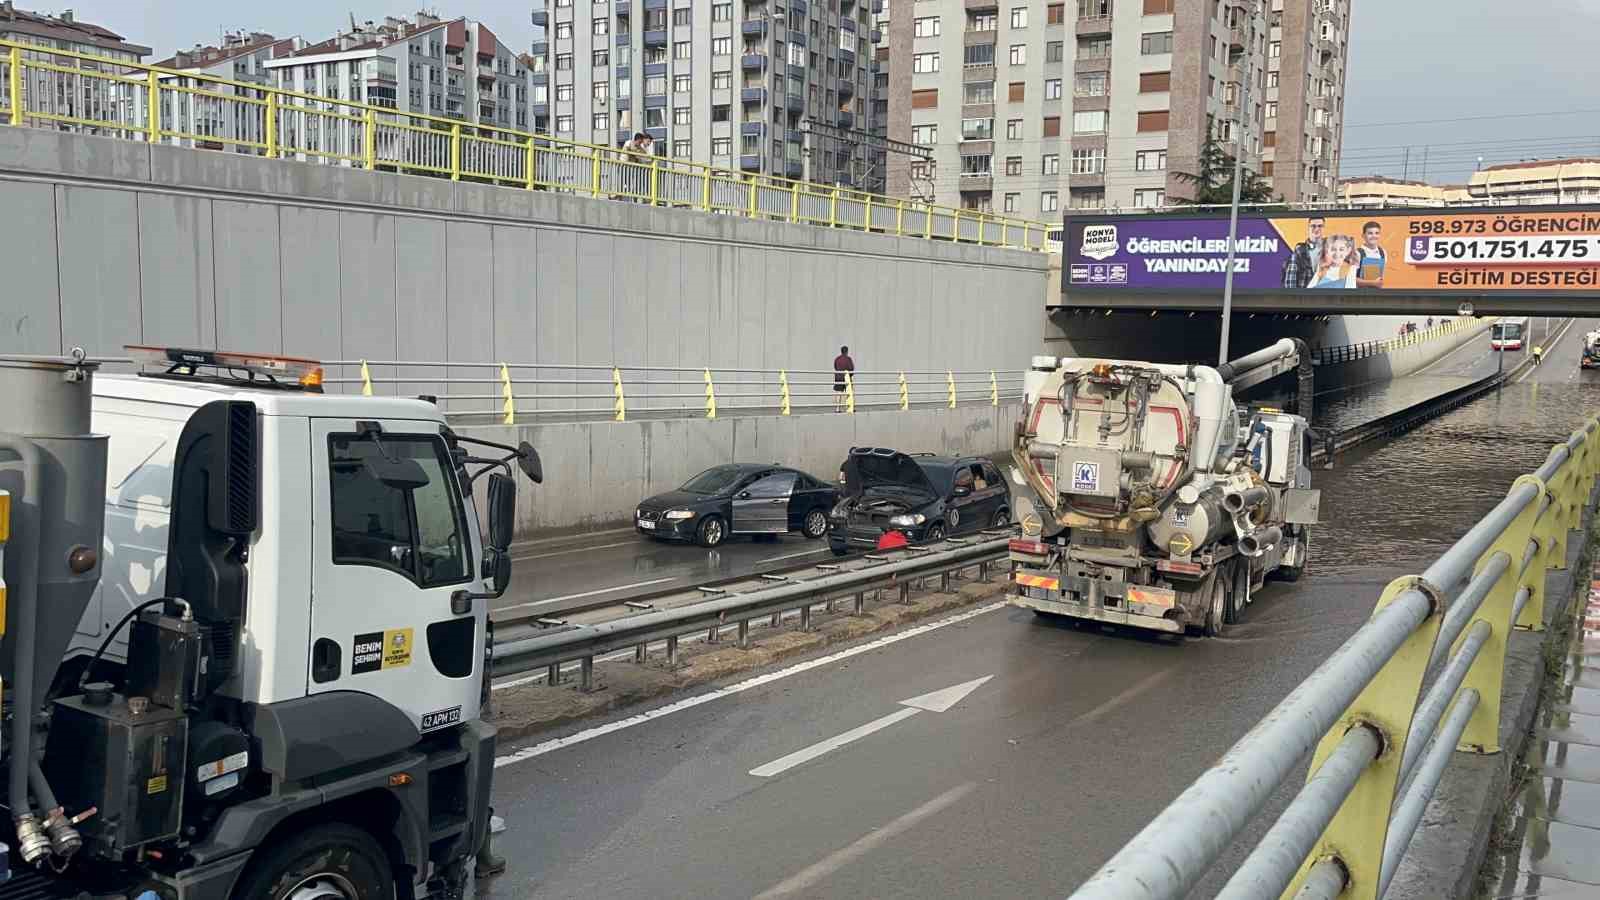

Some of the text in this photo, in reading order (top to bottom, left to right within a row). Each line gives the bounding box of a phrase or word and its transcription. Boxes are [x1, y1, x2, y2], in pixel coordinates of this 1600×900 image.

[1086, 228, 1114, 237] KONYA
[1409, 220, 1486, 234] 598.973
[1415, 240, 1424, 249] 5
[1434, 240, 1588, 258] 501.751.475
[1144, 258, 1250, 273] YANINDAYZ!
[1437, 268, 1597, 285] EĞİTİM DESTEĞİ
[432, 711, 448, 726] APM
